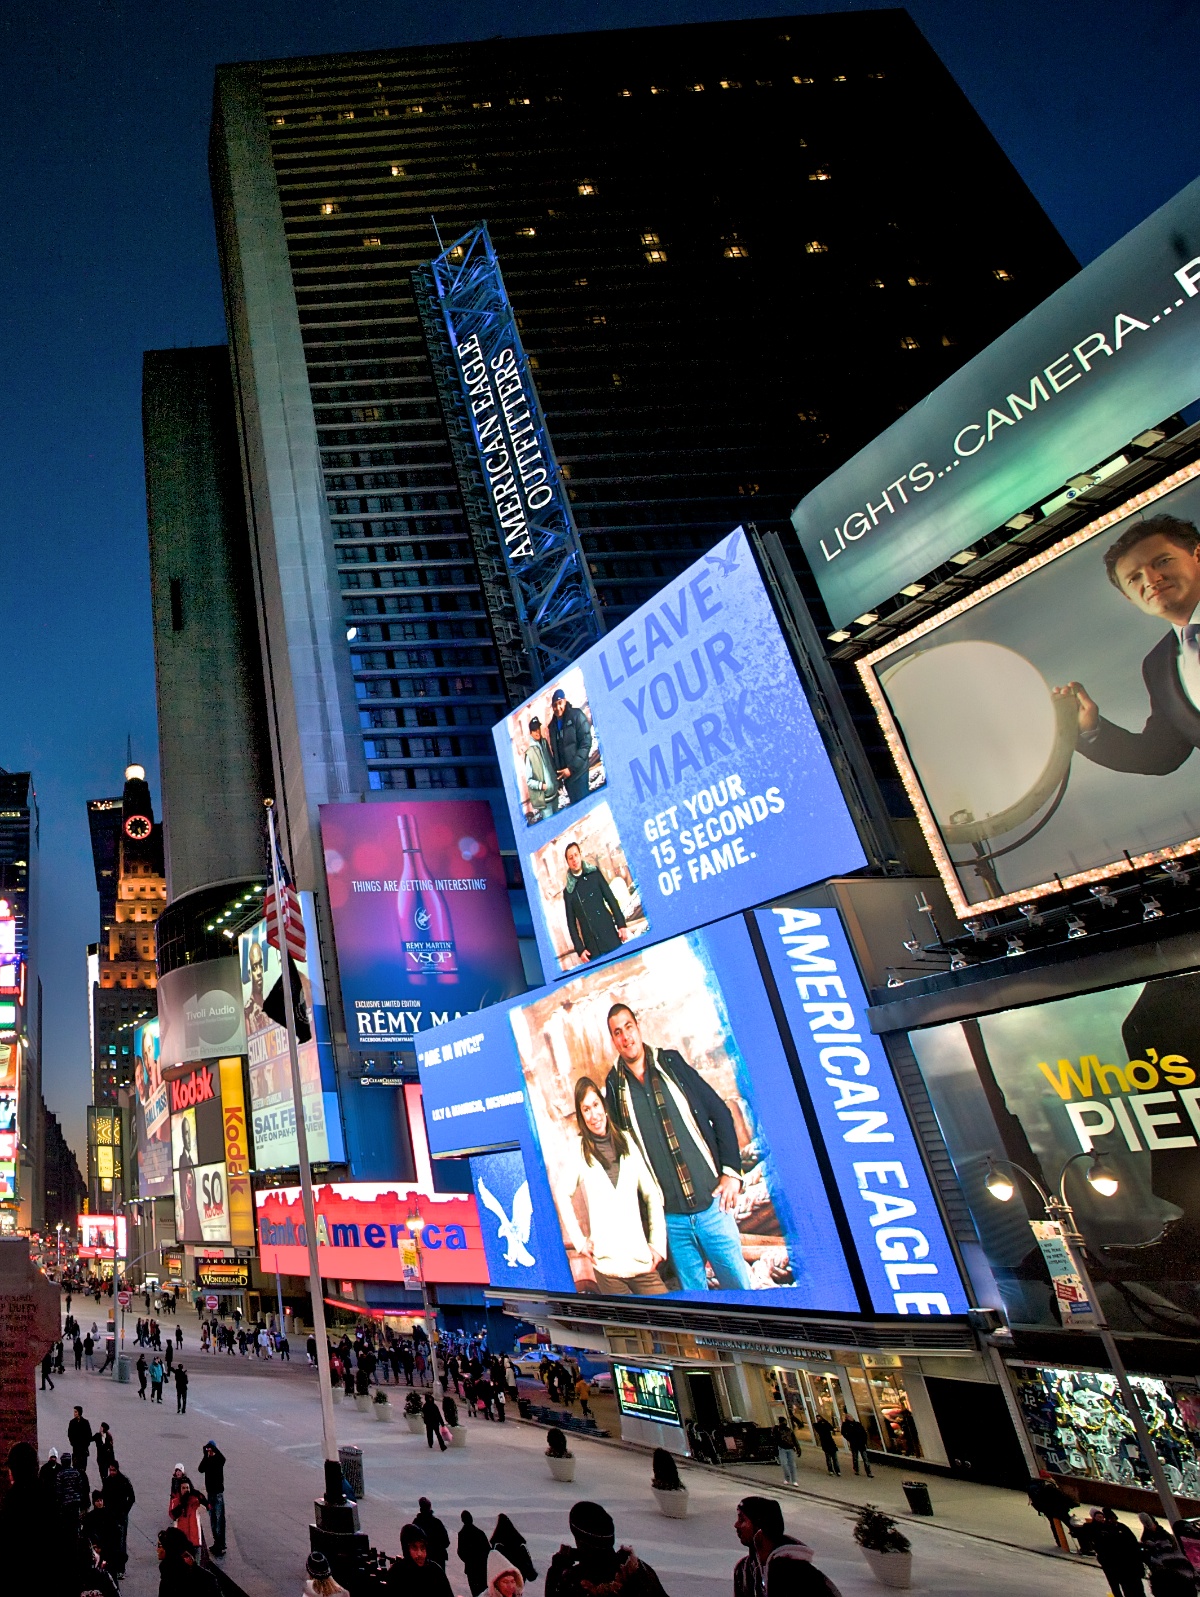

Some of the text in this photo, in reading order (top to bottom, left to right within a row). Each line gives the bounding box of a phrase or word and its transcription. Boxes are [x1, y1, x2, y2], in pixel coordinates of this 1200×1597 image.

[457, 334, 536, 560] AMERICAN EAGLE
[490, 348, 553, 510] OUTFITTERS
[599, 568, 724, 692] LEAVE
[622, 632, 744, 736] YOUR
[628, 689, 763, 801] MARK
[644, 774, 747, 842] GET YOUR
[651, 786, 786, 869] 15 SECONDS
[657, 837, 758, 896] OF FAME.
[351, 878, 487, 893] THINGS ARE GETTING INTERESTING
[408, 951, 452, 963] VSOP
[425, 941, 451, 949] MARTIN
[186, 1004, 236, 1021] Tivoli Audio
[355, 1000, 421, 1008] EXCLUSIVE LIMITED EDITION
[356, 1009, 422, 1034] RÉMY
[172, 1066, 214, 1110] Kodak
[1038, 1048, 1196, 1100] Who's
[254, 1111, 280, 1134] SAT.
[771, 907, 951, 1315] AMERICAN EAGLE
[224, 1106, 248, 1195] Kodak
[255, 1120, 324, 1144] LIVE ON PAY-P-VIEW
[260, 1216, 294, 1247] Bank
[200, 1274, 248, 1286] WONDERLAND
[701, 1337, 828, 1360] AMERICAN EAGLE OUTFITTERS
[874, 1356, 895, 1366] aerie
